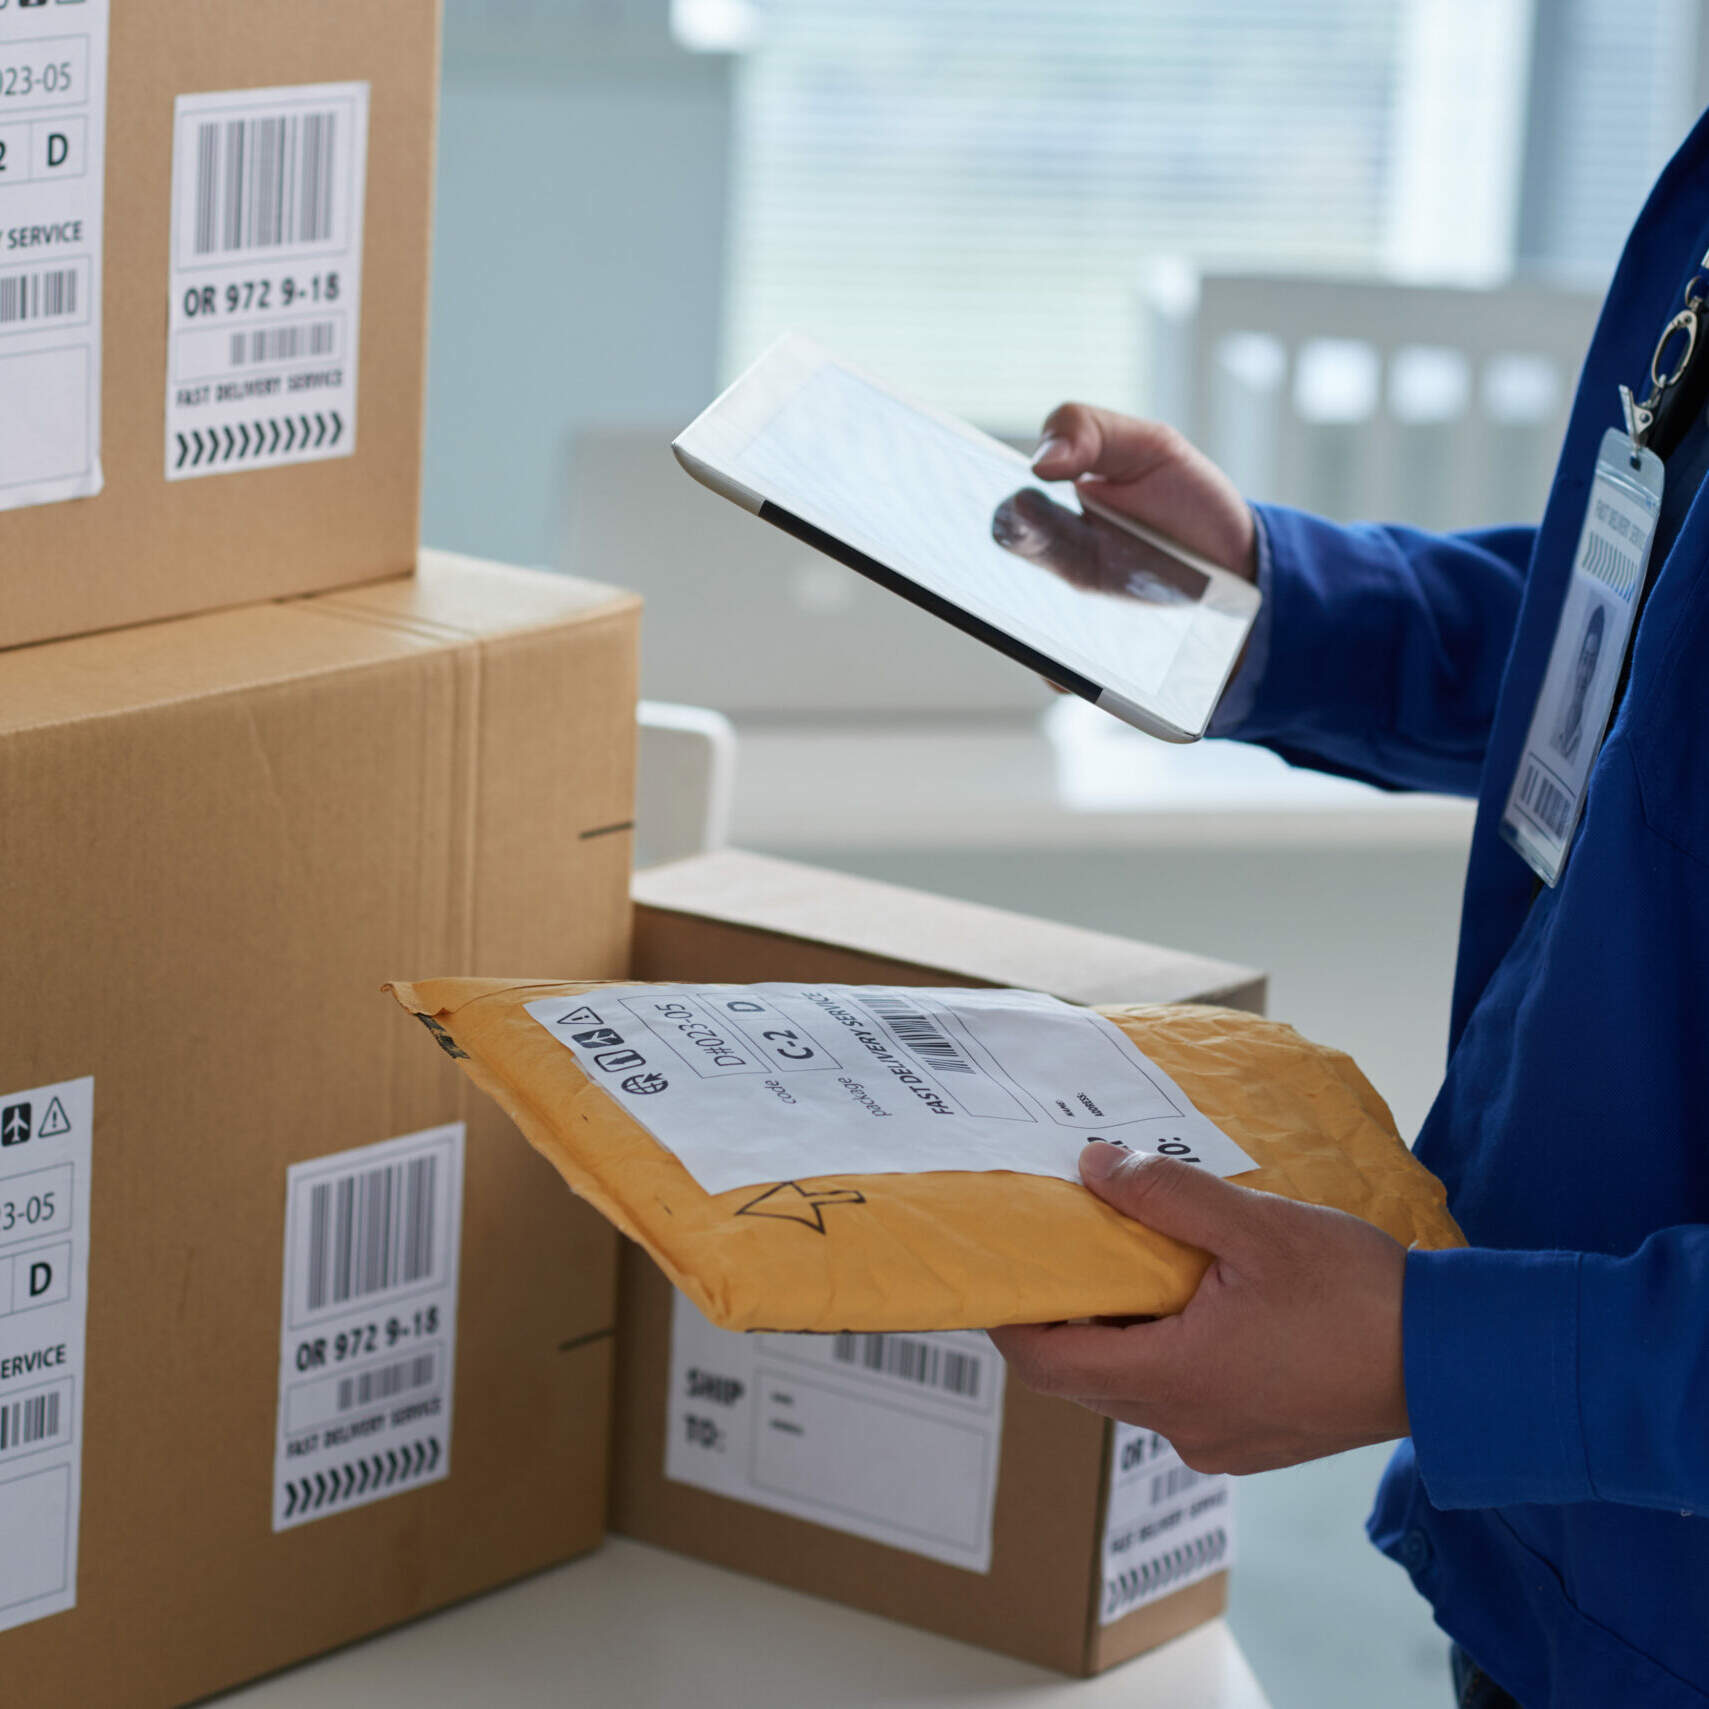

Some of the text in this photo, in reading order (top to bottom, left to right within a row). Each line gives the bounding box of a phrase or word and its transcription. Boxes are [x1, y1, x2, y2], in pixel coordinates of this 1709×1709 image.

[0, 62, 72, 97] 23-05
[47, 132, 69, 168] D
[7, 220, 83, 250] SERVICE
[183, 271, 340, 318] OR 972 9-18
[654, 1003, 746, 1066] D#023-05
[726, 1001, 814, 1060] C-2 D
[800, 992, 955, 1115] FAST DELIVERY SERVICE
[764, 1079, 797, 1104] code
[837, 1076, 893, 1117] package
[0, 1192, 55, 1231] 3-05
[29, 1261, 53, 1297] D
[295, 1304, 439, 1372] OR 972 9-18
[0, 1344, 66, 1380] ERVICE
[685, 1366, 745, 1408] SHIP
